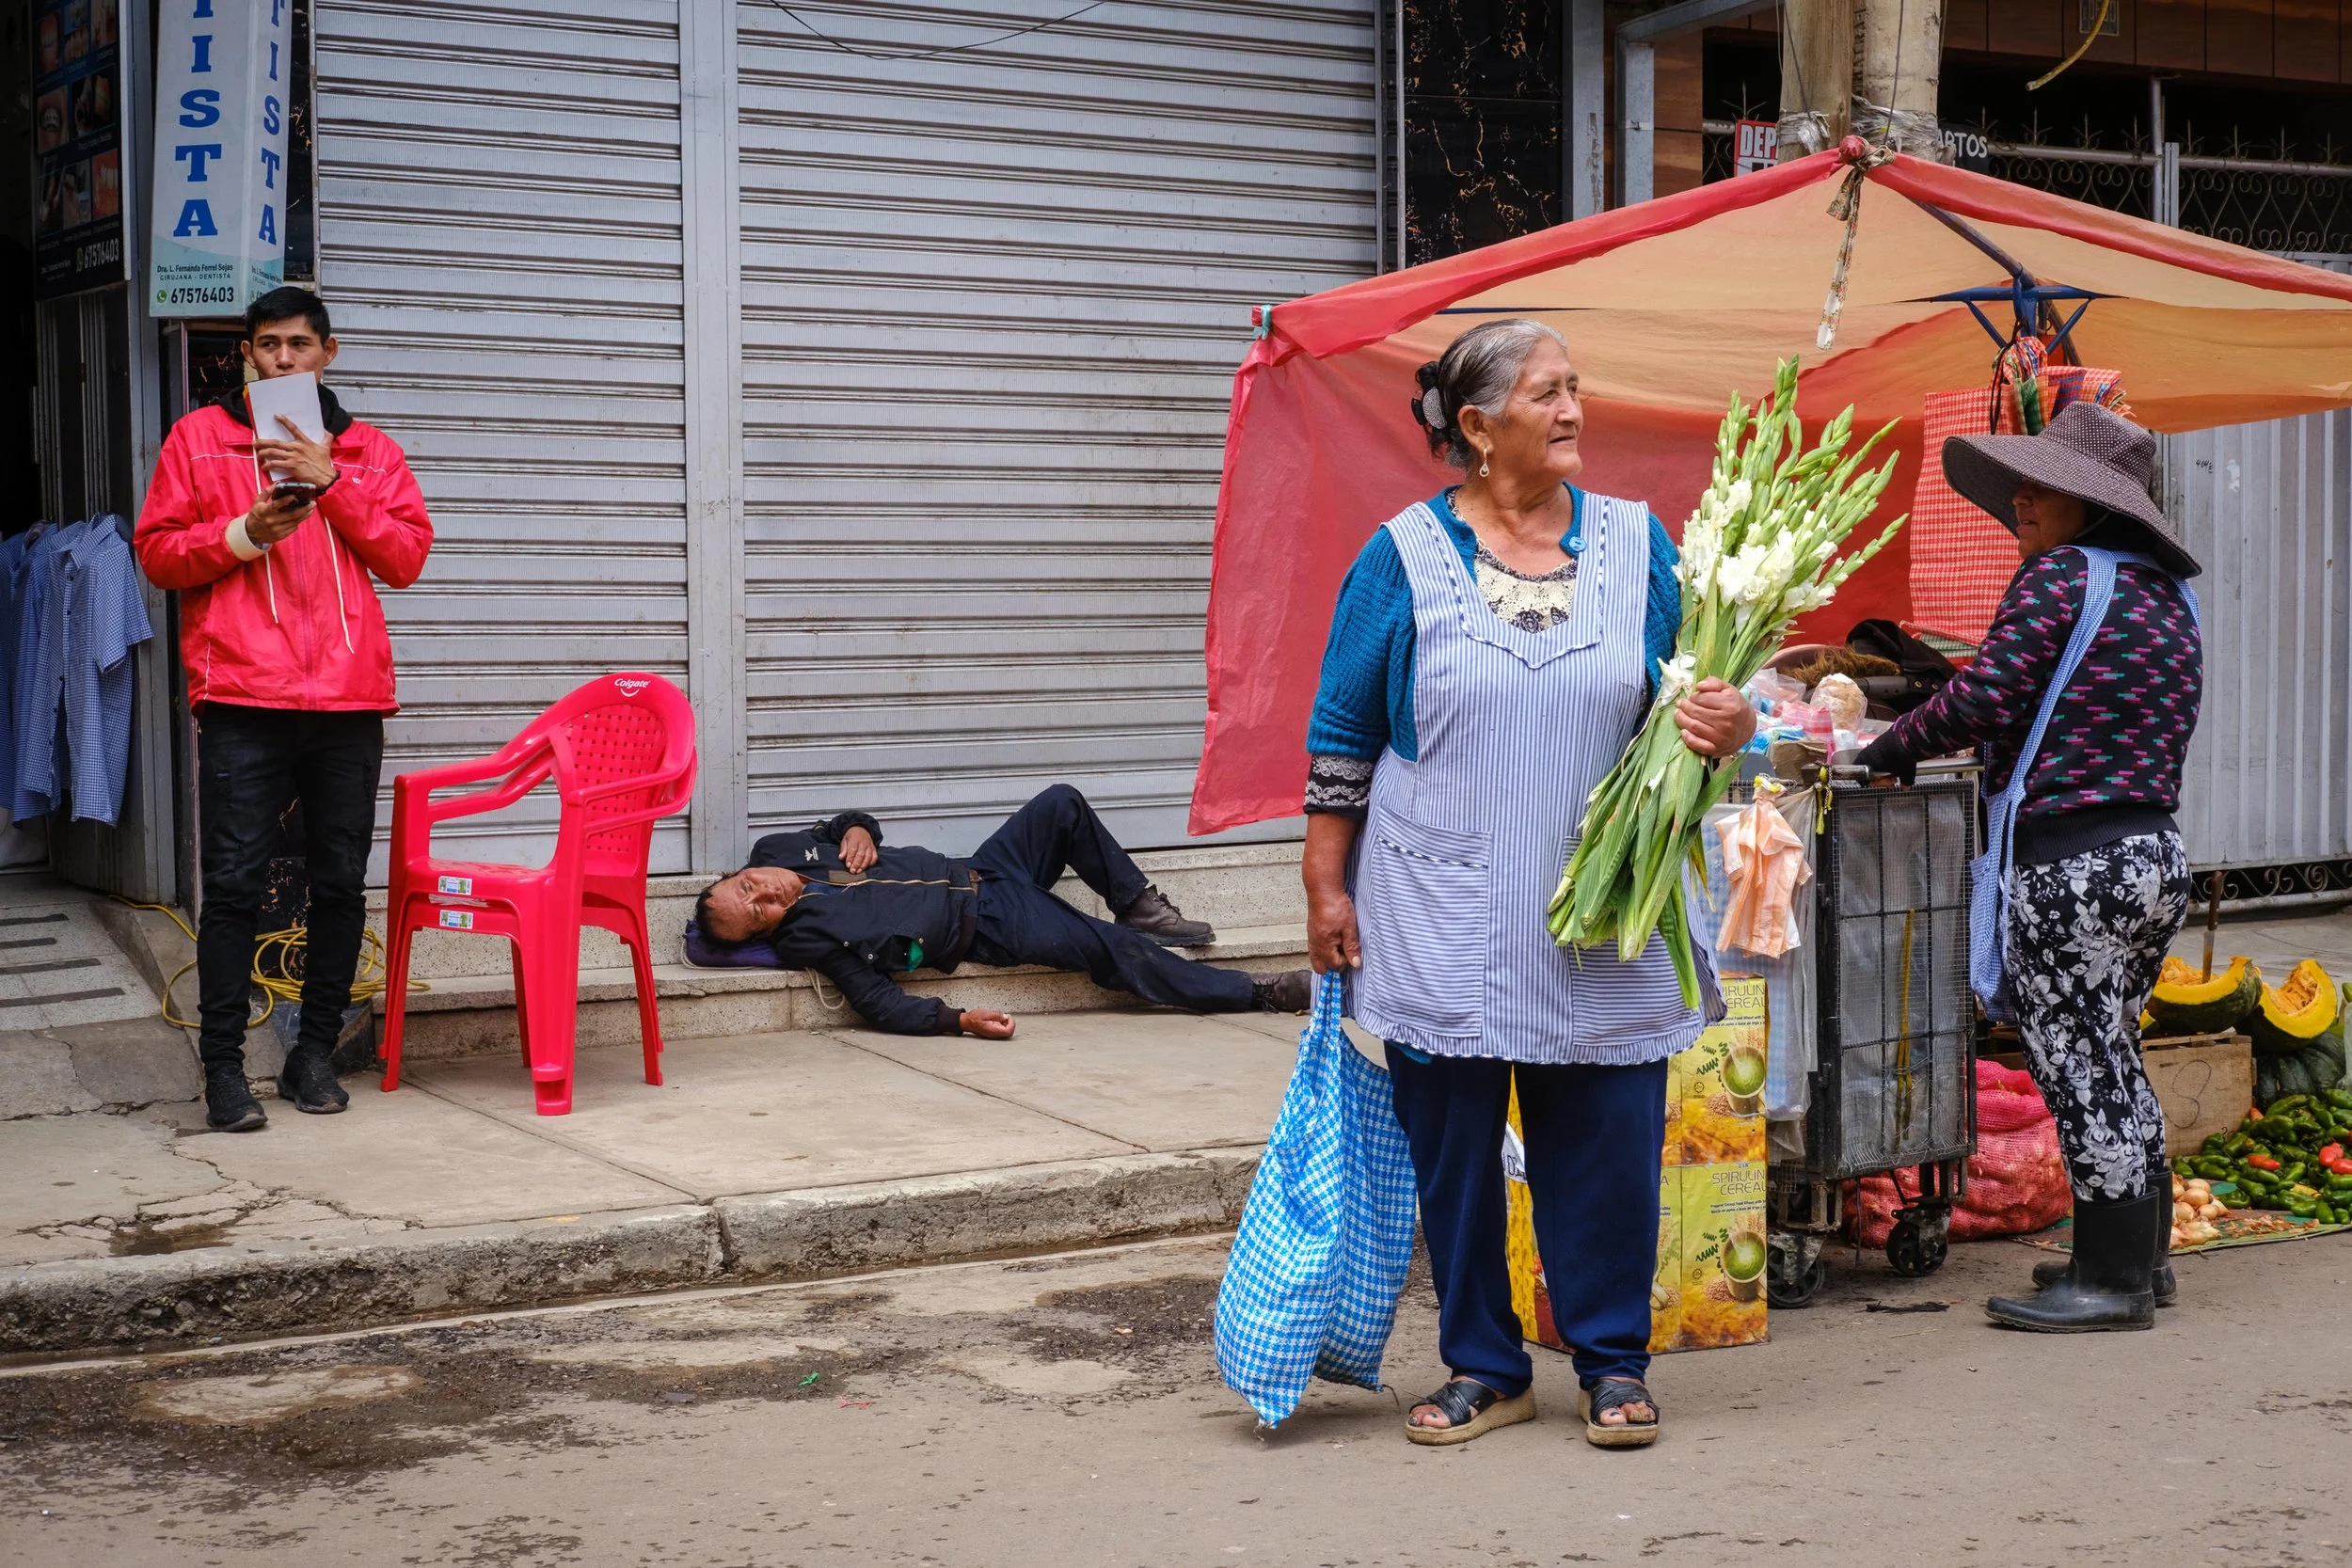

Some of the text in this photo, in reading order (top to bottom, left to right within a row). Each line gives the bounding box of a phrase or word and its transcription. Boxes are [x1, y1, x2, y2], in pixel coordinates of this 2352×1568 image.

[1740, 124, 1778, 159] DEP
[85, 237, 119, 269] 67576403
[169, 264, 174, 273] L.
[175, 264, 200, 273] Fernanda
[171, 287, 234, 304] 67576403
[614, 678, 649, 689] Colgate
[1722, 985, 1765, 996] IRULIN
[1725, 997, 1765, 1009] EREAL
